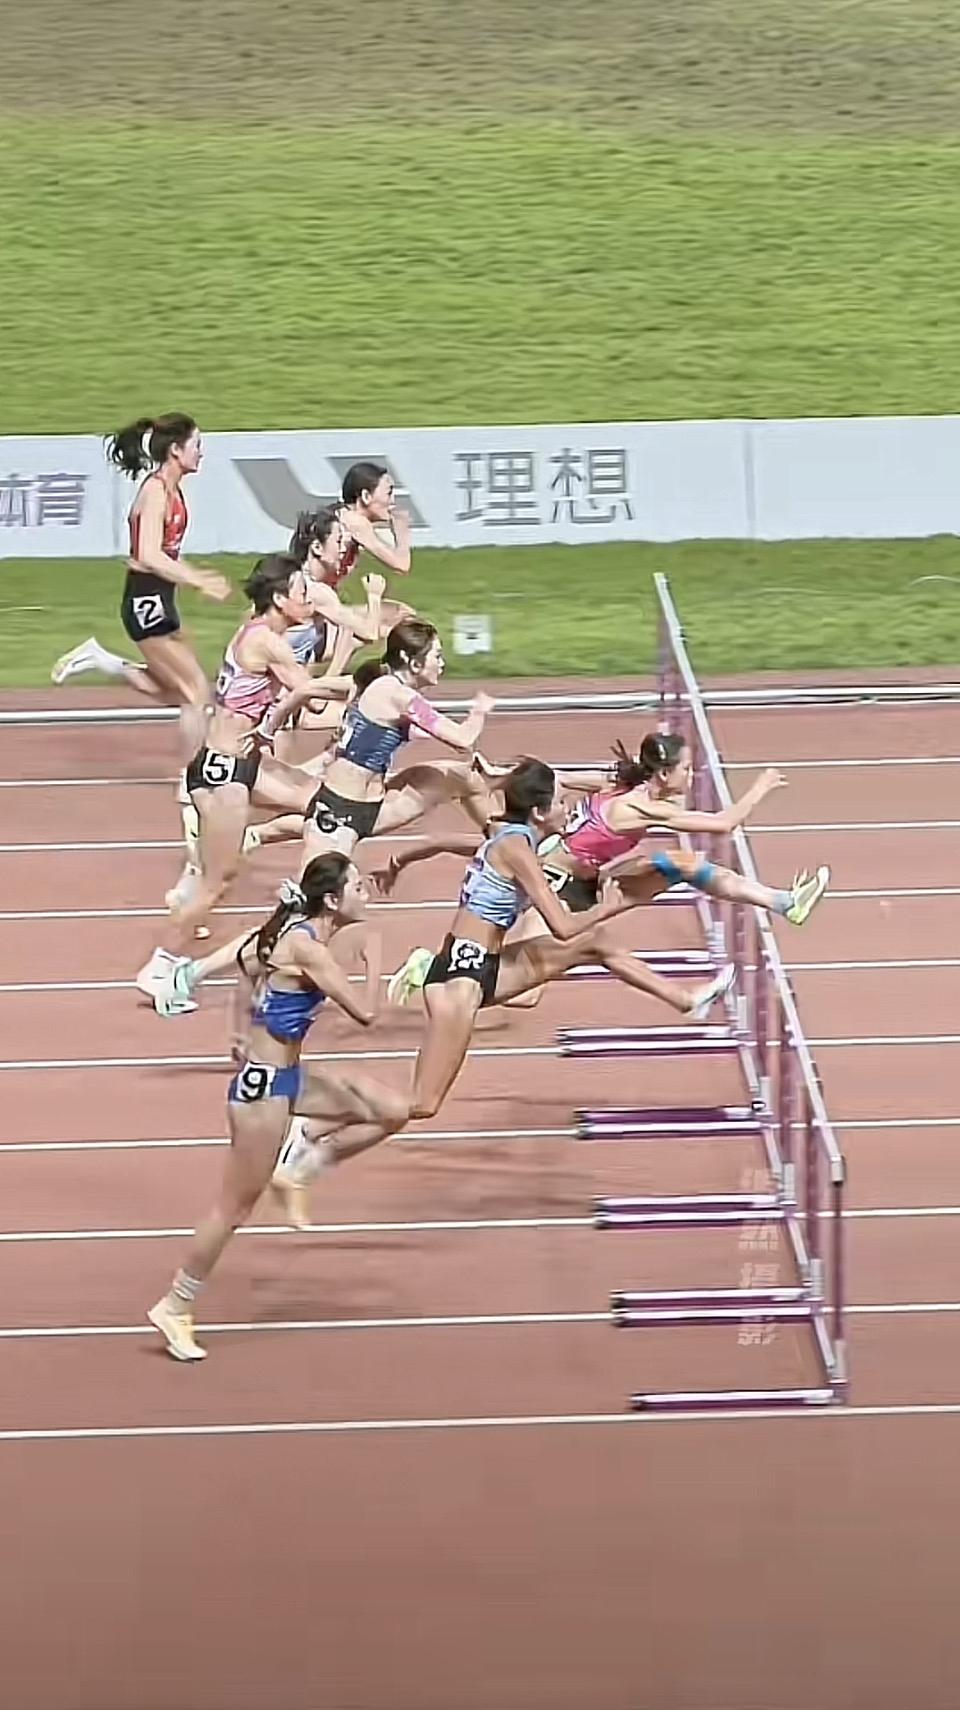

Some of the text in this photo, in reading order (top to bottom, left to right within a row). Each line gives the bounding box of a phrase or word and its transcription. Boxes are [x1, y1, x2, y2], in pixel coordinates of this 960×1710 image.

[453, 447, 634, 525] 理想
[138, 599, 162, 626] 2
[205, 752, 229, 782] 5
[240, 1066, 268, 1102] 9
